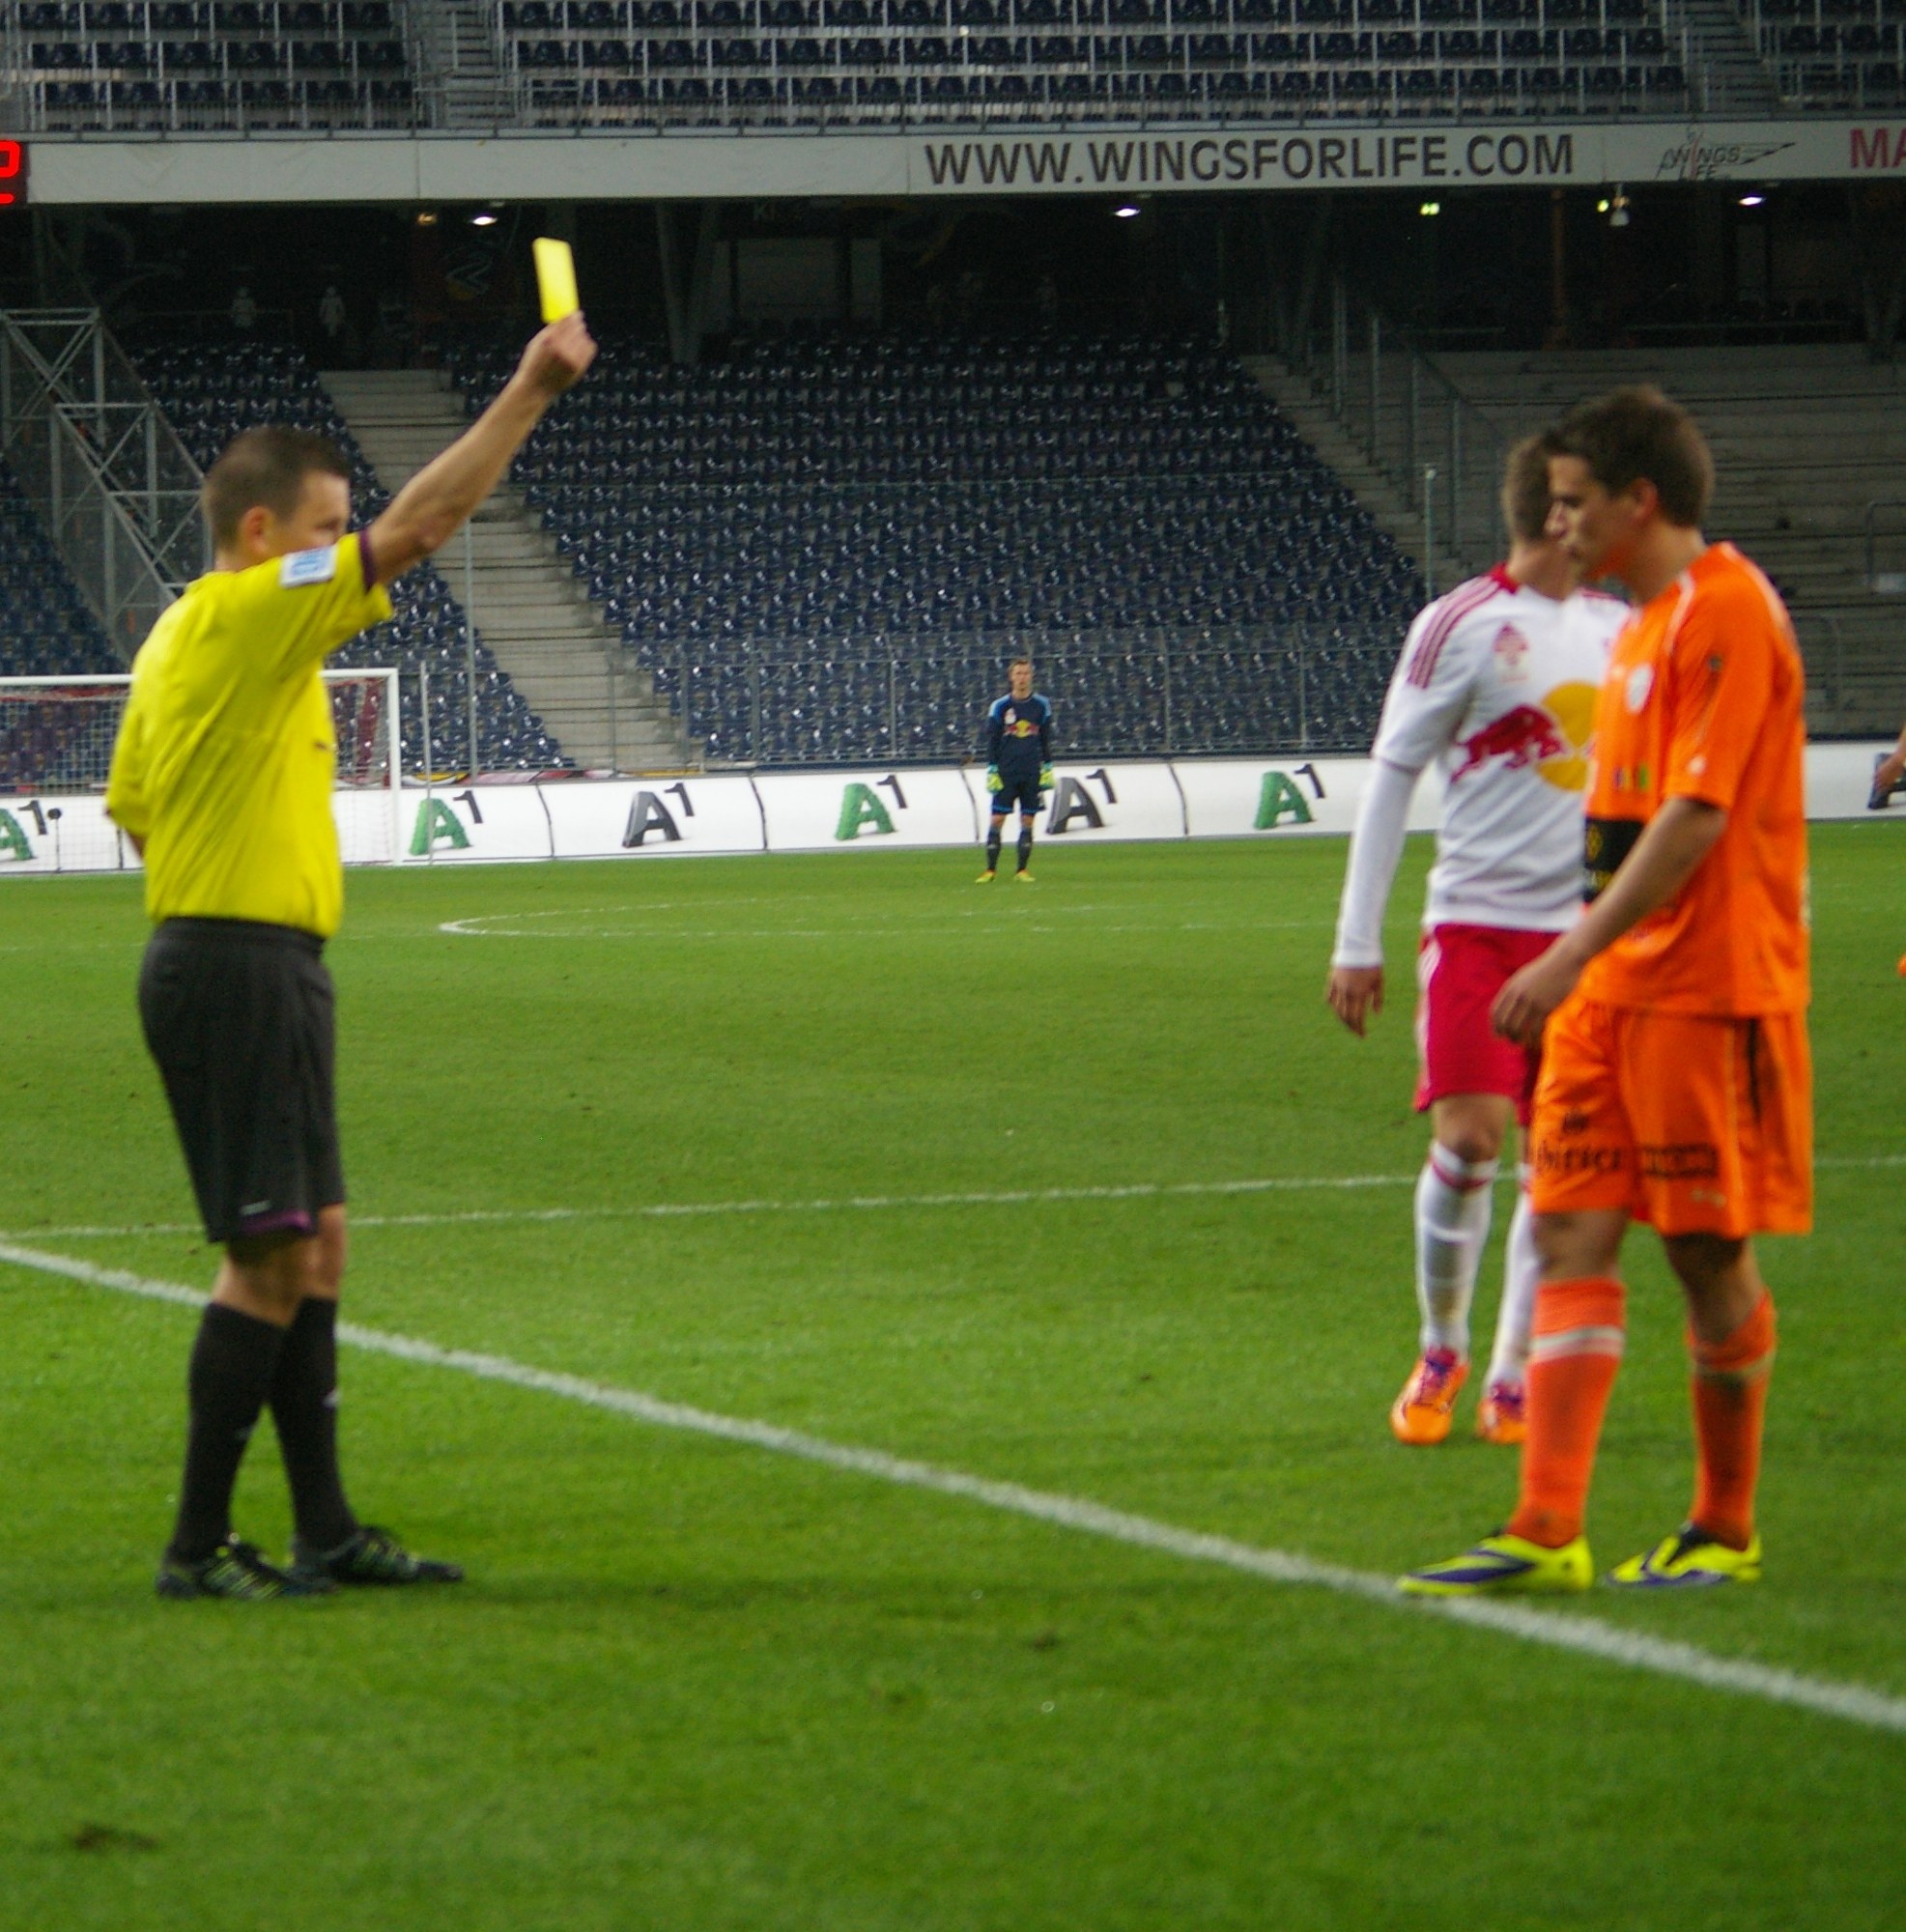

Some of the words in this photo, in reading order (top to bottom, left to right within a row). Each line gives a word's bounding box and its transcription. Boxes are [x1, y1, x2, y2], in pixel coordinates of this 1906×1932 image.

[925, 134, 1574, 185] WWW.WINGSFORLIFE.COM
[410, 790, 483, 855] A1
[623, 782, 694, 848] A1
[835, 775, 907, 840] A1
[1045, 769, 1117, 834] A1
[1253, 763, 1324, 830] A1
